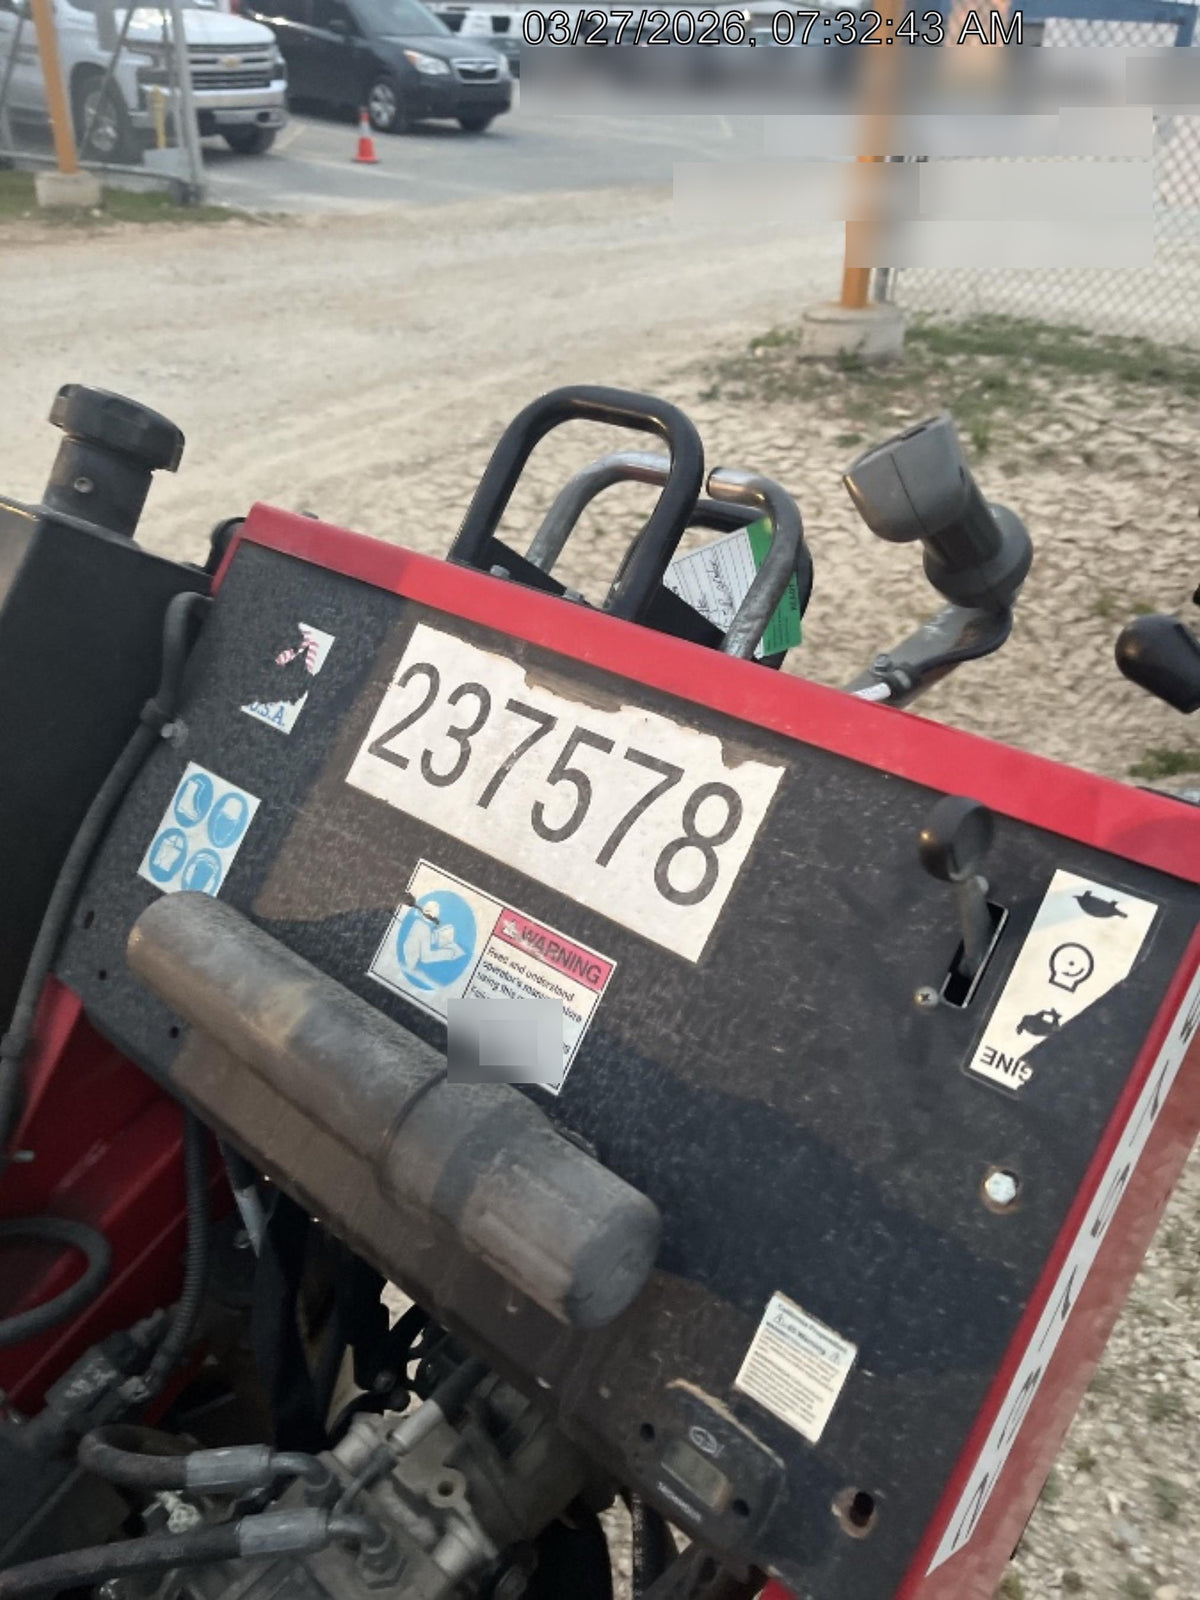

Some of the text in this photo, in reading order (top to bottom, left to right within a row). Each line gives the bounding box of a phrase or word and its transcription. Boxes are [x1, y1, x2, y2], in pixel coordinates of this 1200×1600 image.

[368, 662, 744, 906] 237578
[521, 925, 601, 985] WARNING
[980, 1045, 1033, 1083] GINE
